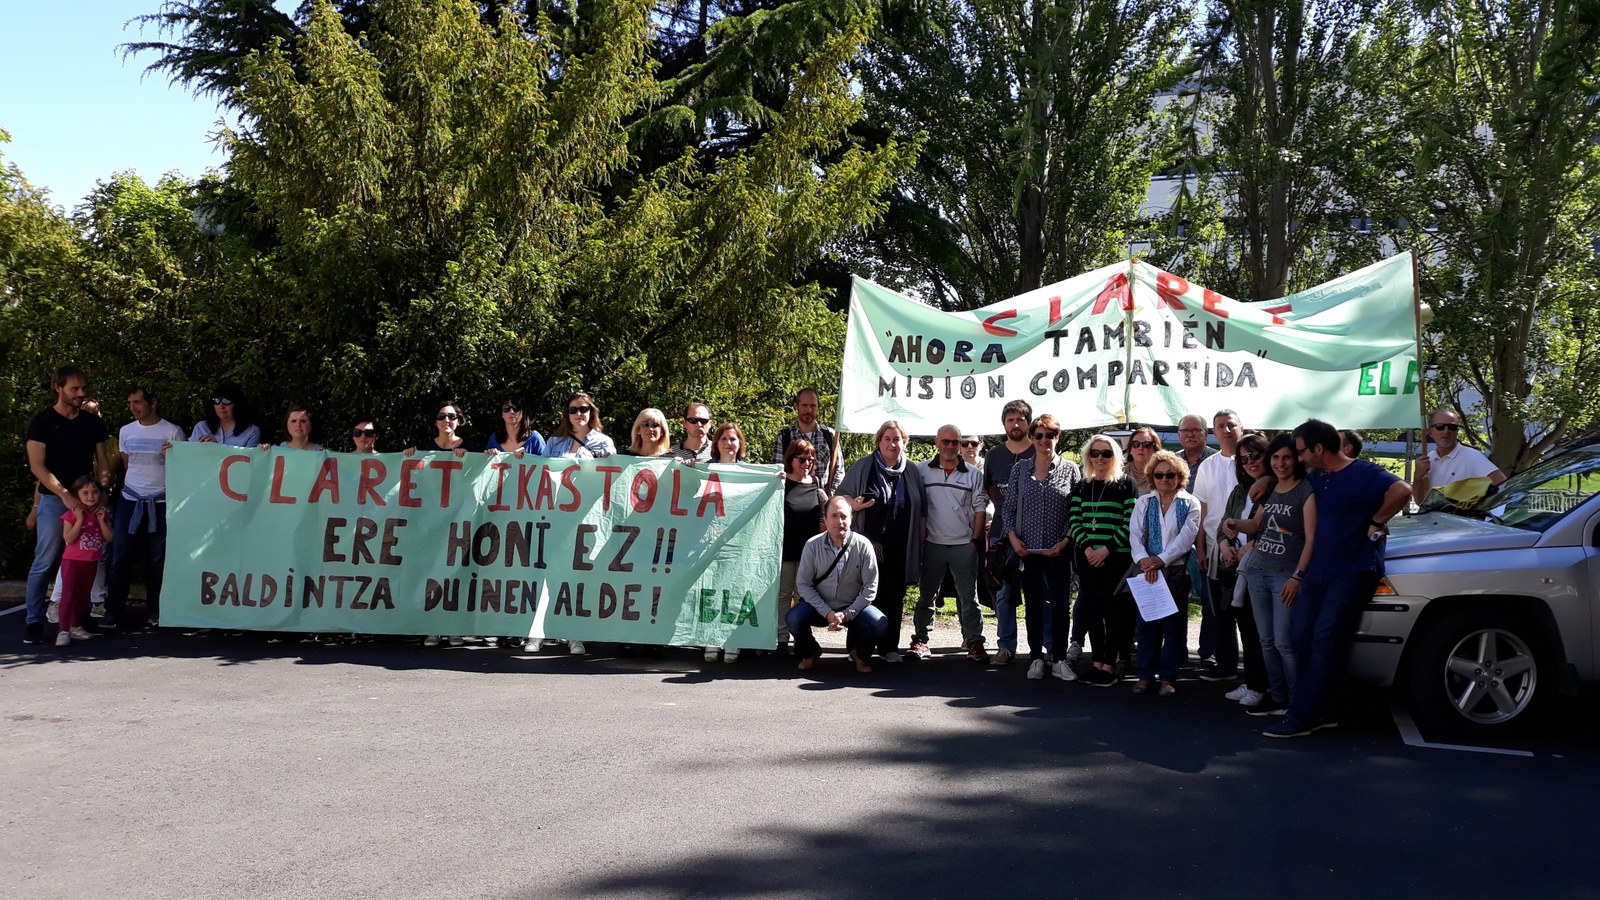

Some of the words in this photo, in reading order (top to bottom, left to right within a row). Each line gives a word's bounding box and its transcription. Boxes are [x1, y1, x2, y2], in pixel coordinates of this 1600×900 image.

[982, 272, 1292, 337] CLARET
[1044, 313, 1226, 357] TAMBIÉN
[878, 368, 1005, 400] MISIÓN
[1358, 360, 1419, 396] ELA
[219, 455, 463, 508] CLARET
[487, 462, 726, 517] IKASTOLA
[323, 517, 407, 566] ERE
[446, 515, 551, 569] HONI
[572, 524, 678, 574] EZ!!
[201, 568, 396, 611] BALDINTZA
[699, 588, 759, 628] ELA
